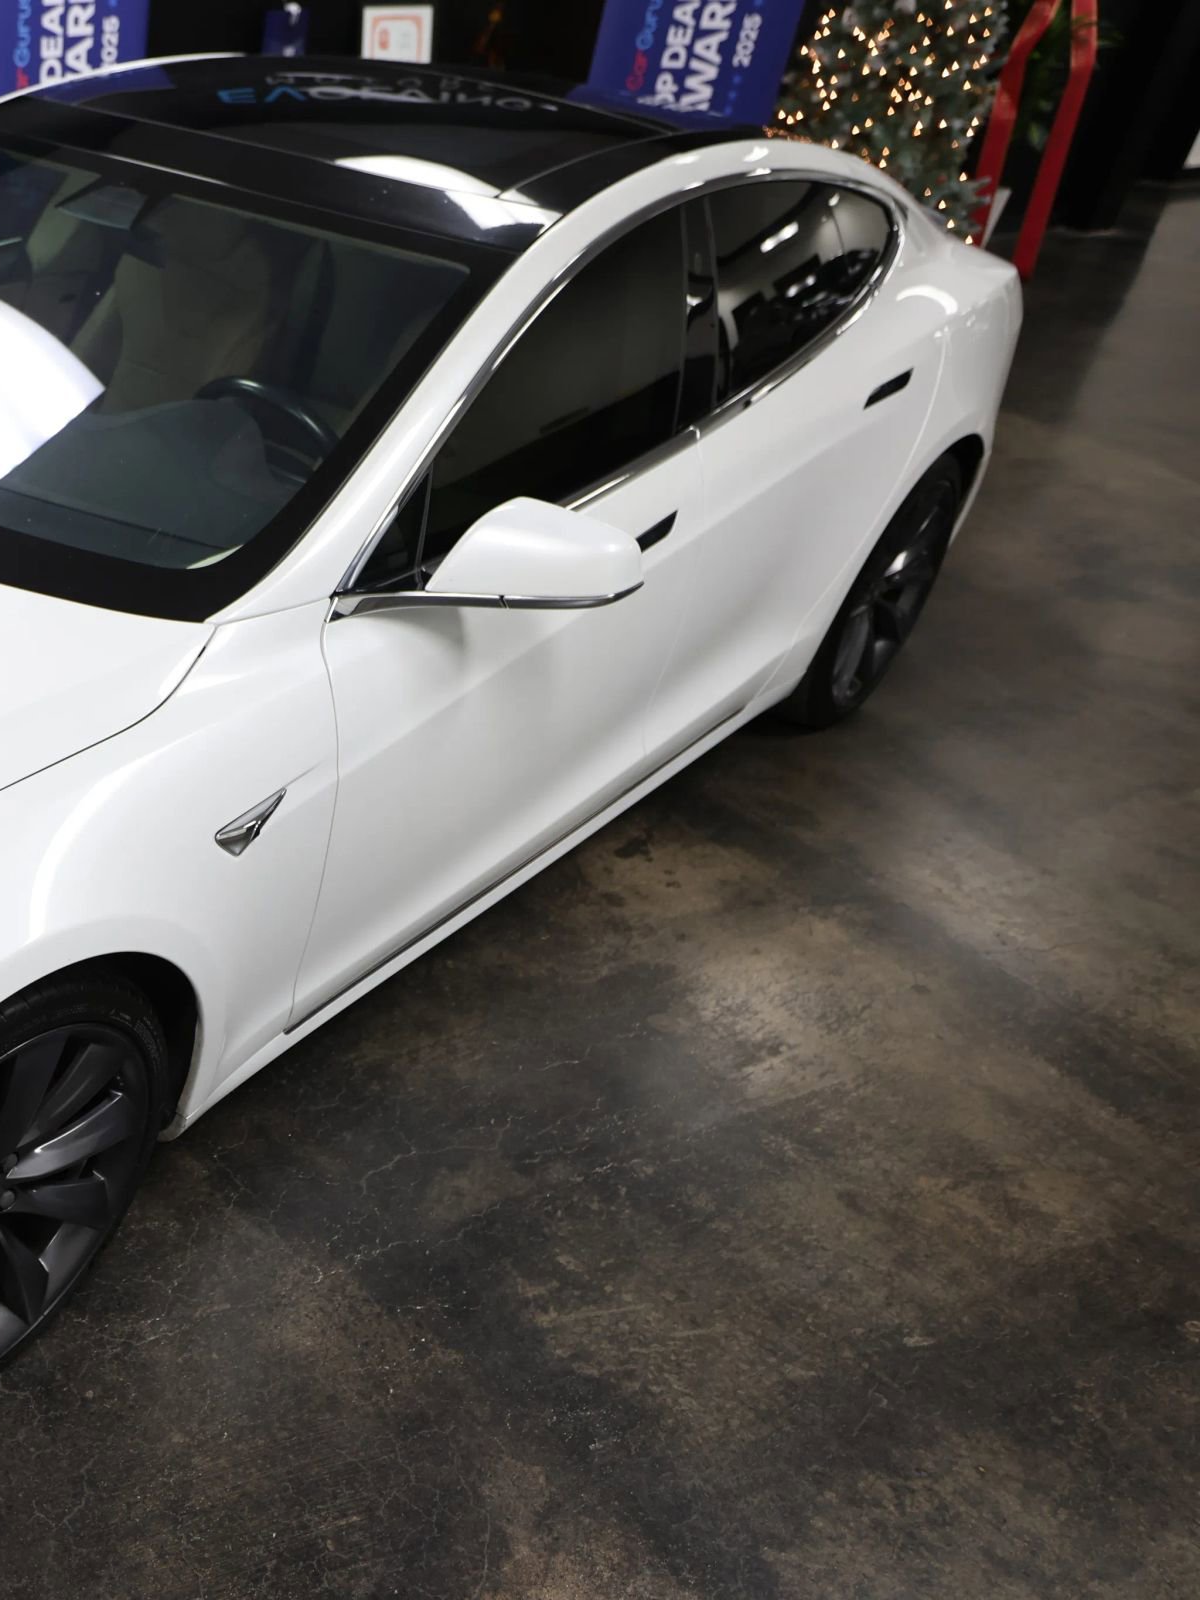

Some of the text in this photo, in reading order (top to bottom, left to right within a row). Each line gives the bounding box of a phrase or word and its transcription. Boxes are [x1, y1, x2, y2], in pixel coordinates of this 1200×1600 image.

[40, 0, 64, 84] DEA
[662, 0, 701, 69] DEA
[679, 0, 737, 111] WAR
[732, 12, 762, 68] 2025
